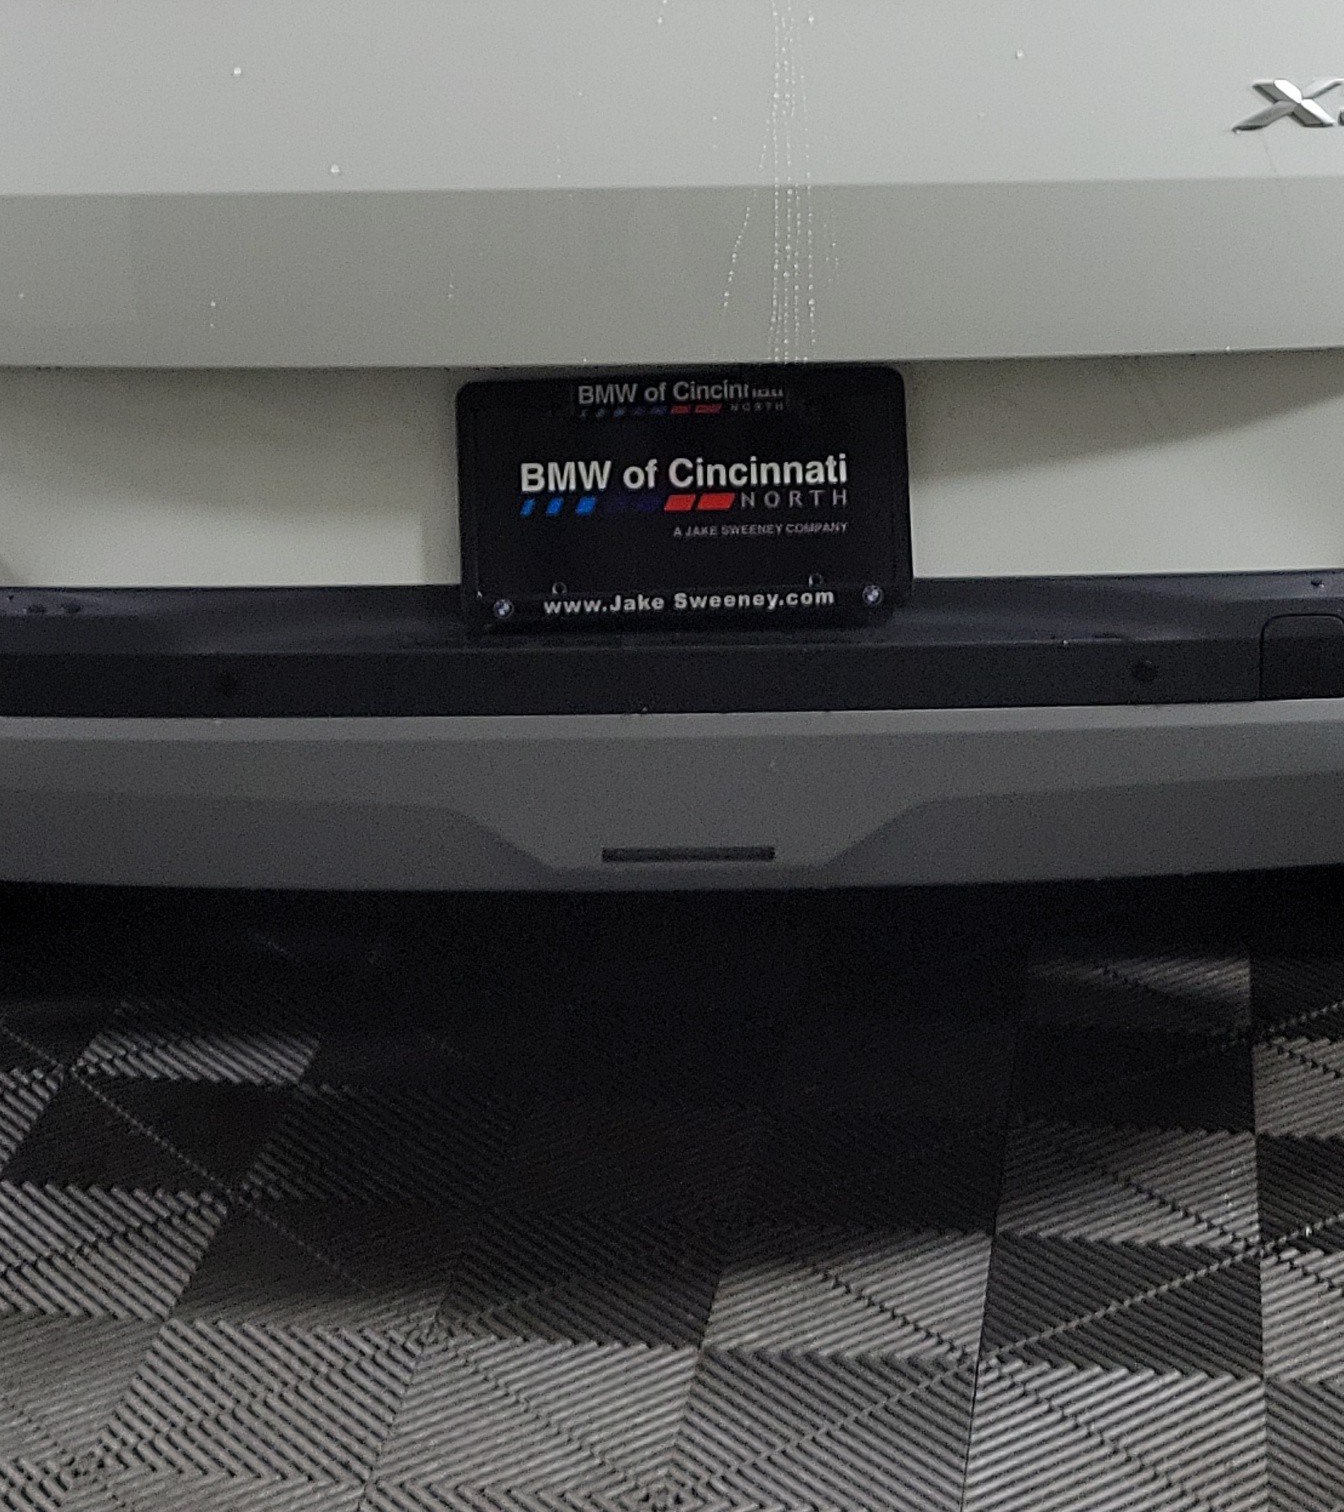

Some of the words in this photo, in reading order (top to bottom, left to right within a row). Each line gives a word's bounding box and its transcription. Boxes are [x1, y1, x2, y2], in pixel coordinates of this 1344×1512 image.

[578, 383, 638, 405] BMW
[644, 382, 667, 402] of
[520, 460, 612, 492] BMW
[623, 456, 657, 488] of
[668, 453, 848, 488] Cincinnati
[741, 489, 848, 508] NORTH
[673, 526, 683, 537] A
[685, 525, 719, 537] JAKE
[721, 523, 783, 536] SWEENEY
[785, 521, 849, 534] COMPANY
[543, 594, 664, 615] www.Jake
[674, 589, 835, 611] Sweeney.com
